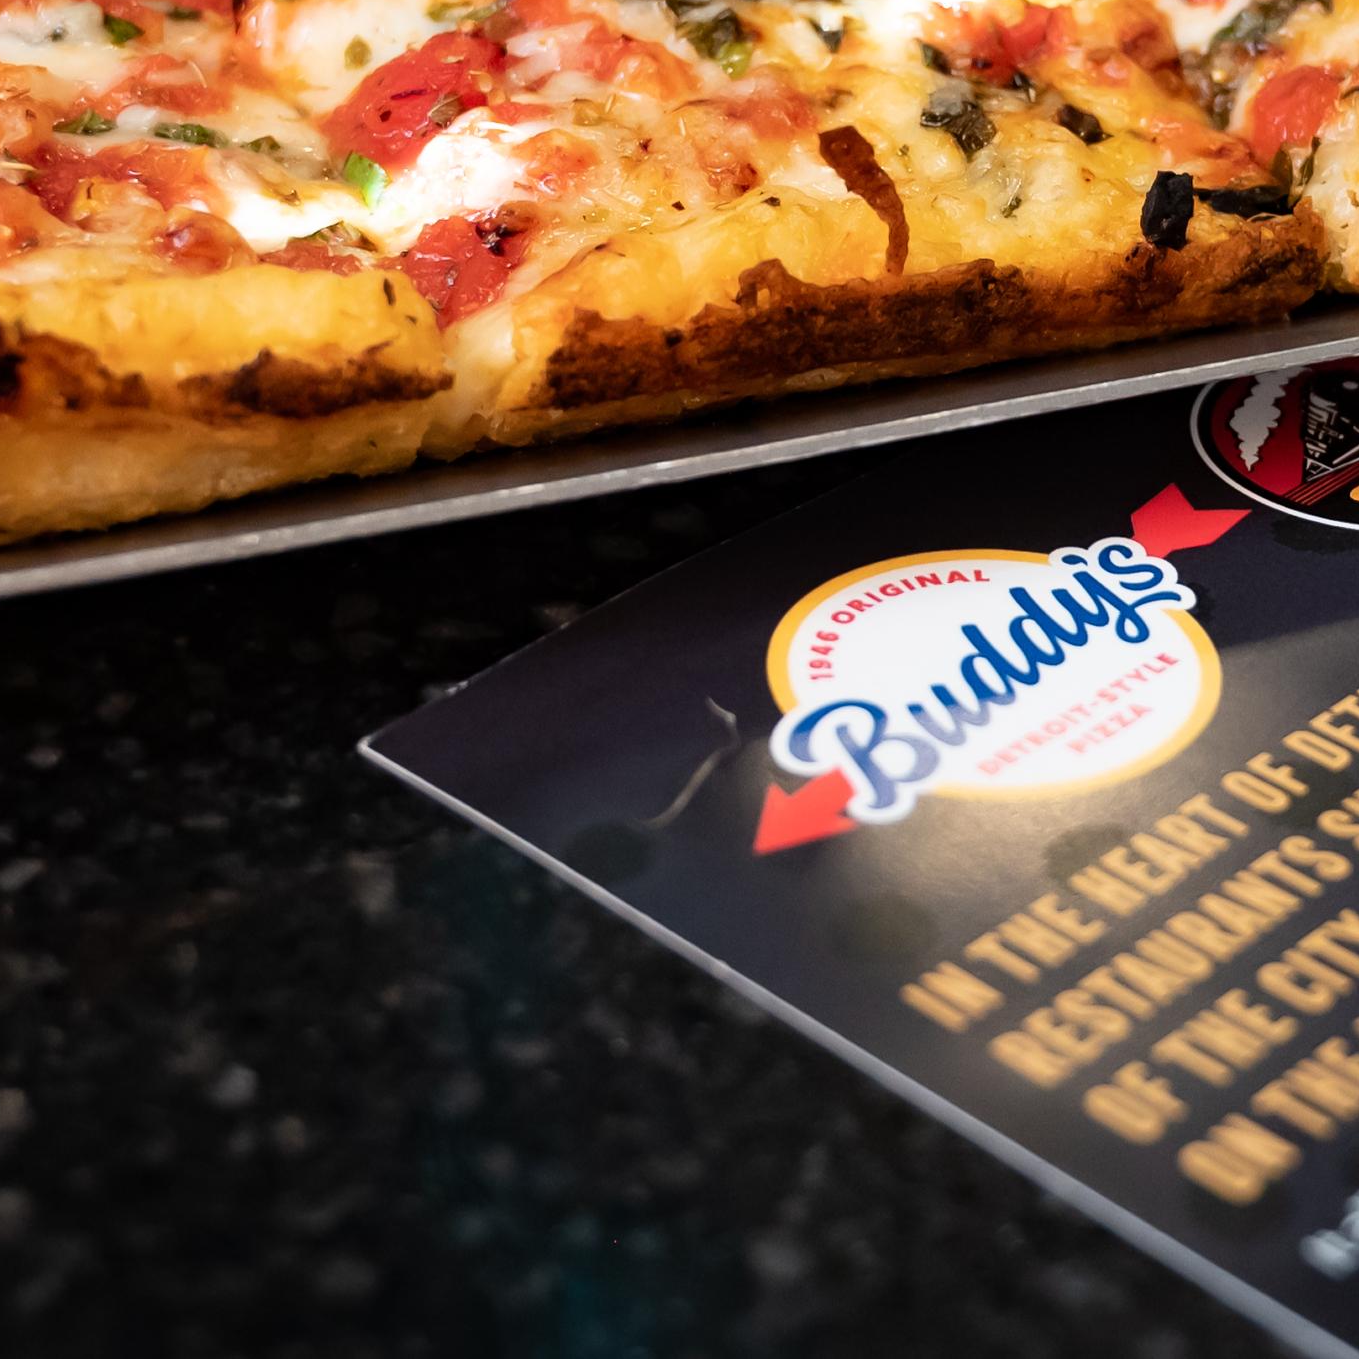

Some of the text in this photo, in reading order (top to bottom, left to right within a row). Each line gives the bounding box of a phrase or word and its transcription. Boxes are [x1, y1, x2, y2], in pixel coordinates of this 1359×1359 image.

[787, 543, 1183, 810] Buddy's
[807, 567, 992, 682] 1946 ORIGINAL
[977, 652, 1180, 776] DETROIT-STYLE
[1068, 703, 1152, 754] PIZZA
[900, 960, 1006, 1033] IN
[965, 893, 1109, 984] THE
[1070, 794, 1250, 918] HEART
[1222, 753, 1309, 813] OF
[988, 836, 1353, 1089] RESTAURANTS
[1083, 1060, 1189, 1145] OF
[1151, 988, 1299, 1087] THE
[1177, 1112, 1302, 1206] ON
